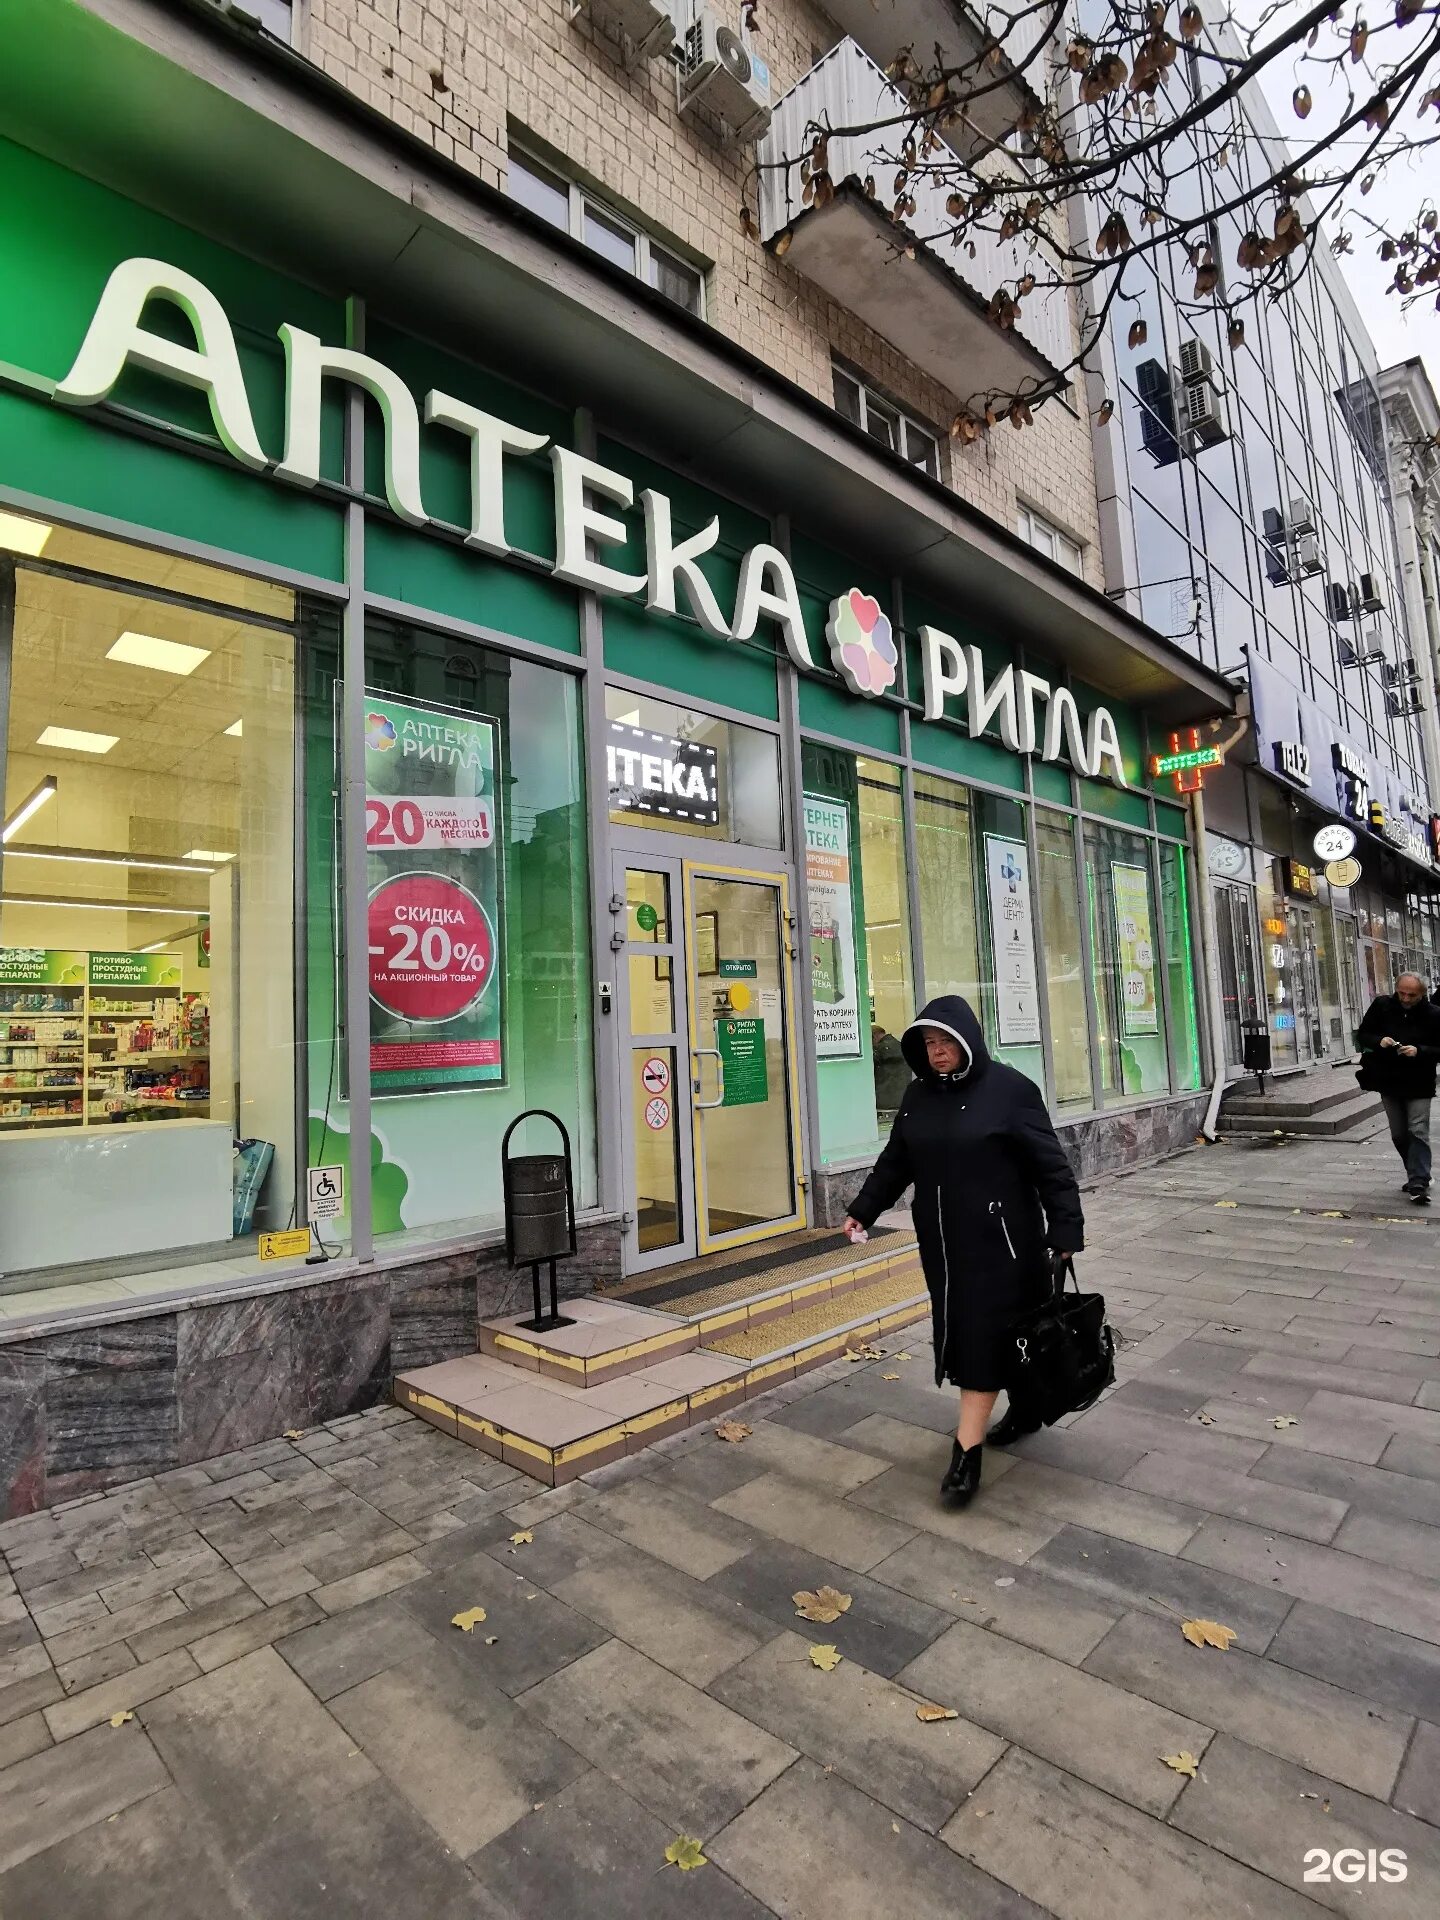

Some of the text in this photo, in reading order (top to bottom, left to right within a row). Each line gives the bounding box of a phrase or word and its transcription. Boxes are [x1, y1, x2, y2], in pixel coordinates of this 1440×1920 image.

[51, 257, 1127, 789] АПТЕКА РИГЛА
[402, 719, 482, 750] АПТЕКА
[402, 737, 483, 771] РИГЛА
[366, 800, 425, 845] 20
[426, 818, 479, 831] КАЖДОГО
[440, 829, 481, 840] МЕСЯЦА
[1318, 829, 1351, 846] TOBACCO
[1326, 840, 1343, 852] 24
[394, 905, 466, 926] СКИДКА
[1003, 909, 1024, 921] ЦЕНТР
[92, 956, 134, 965] ПРОТИВО-
[92, 965, 148, 974] ПРОСТУДНЫЕ
[725, 963, 752, 972] ОТКРЫТО
[92, 973, 141, 981] ПРЕПАРАТЫ
[374, 972, 477, 983] НА АКЦИОННЫЙ ТОВАР
[829, 1008, 856, 1018] КОРЗИНУ
[830, 1020, 852, 1030] АПТЕКУ
[838, 1032, 857, 1042] ЗАКАЗ
